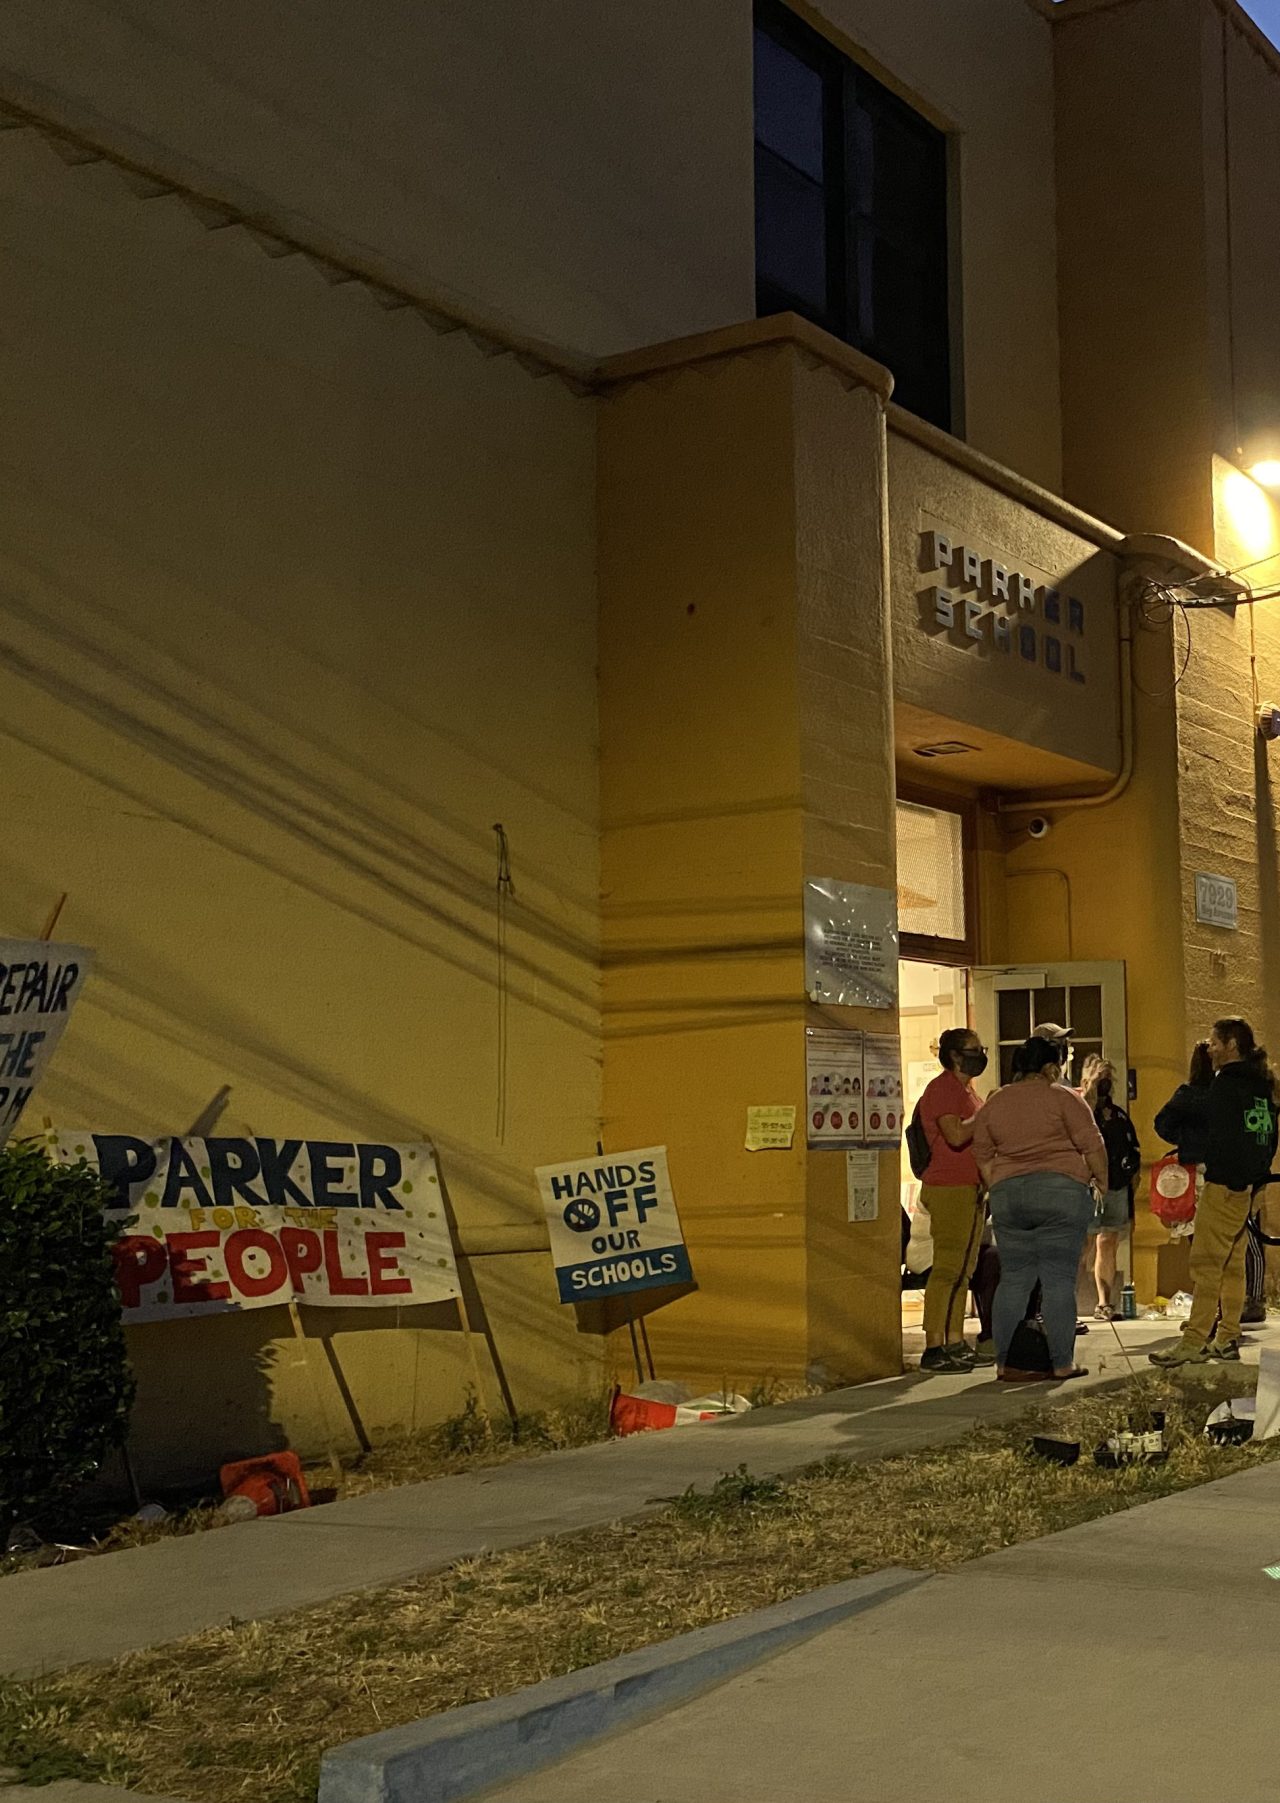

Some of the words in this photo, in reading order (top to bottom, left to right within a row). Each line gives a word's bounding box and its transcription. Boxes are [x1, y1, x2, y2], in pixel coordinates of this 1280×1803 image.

[933, 532, 1084, 637] PARKER
[935, 586, 1086, 684] SCHOOL
[1200, 879, 1233, 909] 7929
[91, 1134, 404, 1210] PARKER
[551, 1161, 656, 1200] HANDS
[189, 1206, 260, 1231] FOR
[284, 1207, 338, 1230] THE
[563, 1184, 658, 1233] OFF
[591, 1230, 641, 1254] OUR
[112, 1227, 413, 1308] PEOPLE
[571, 1253, 677, 1290] SCHOOLS
